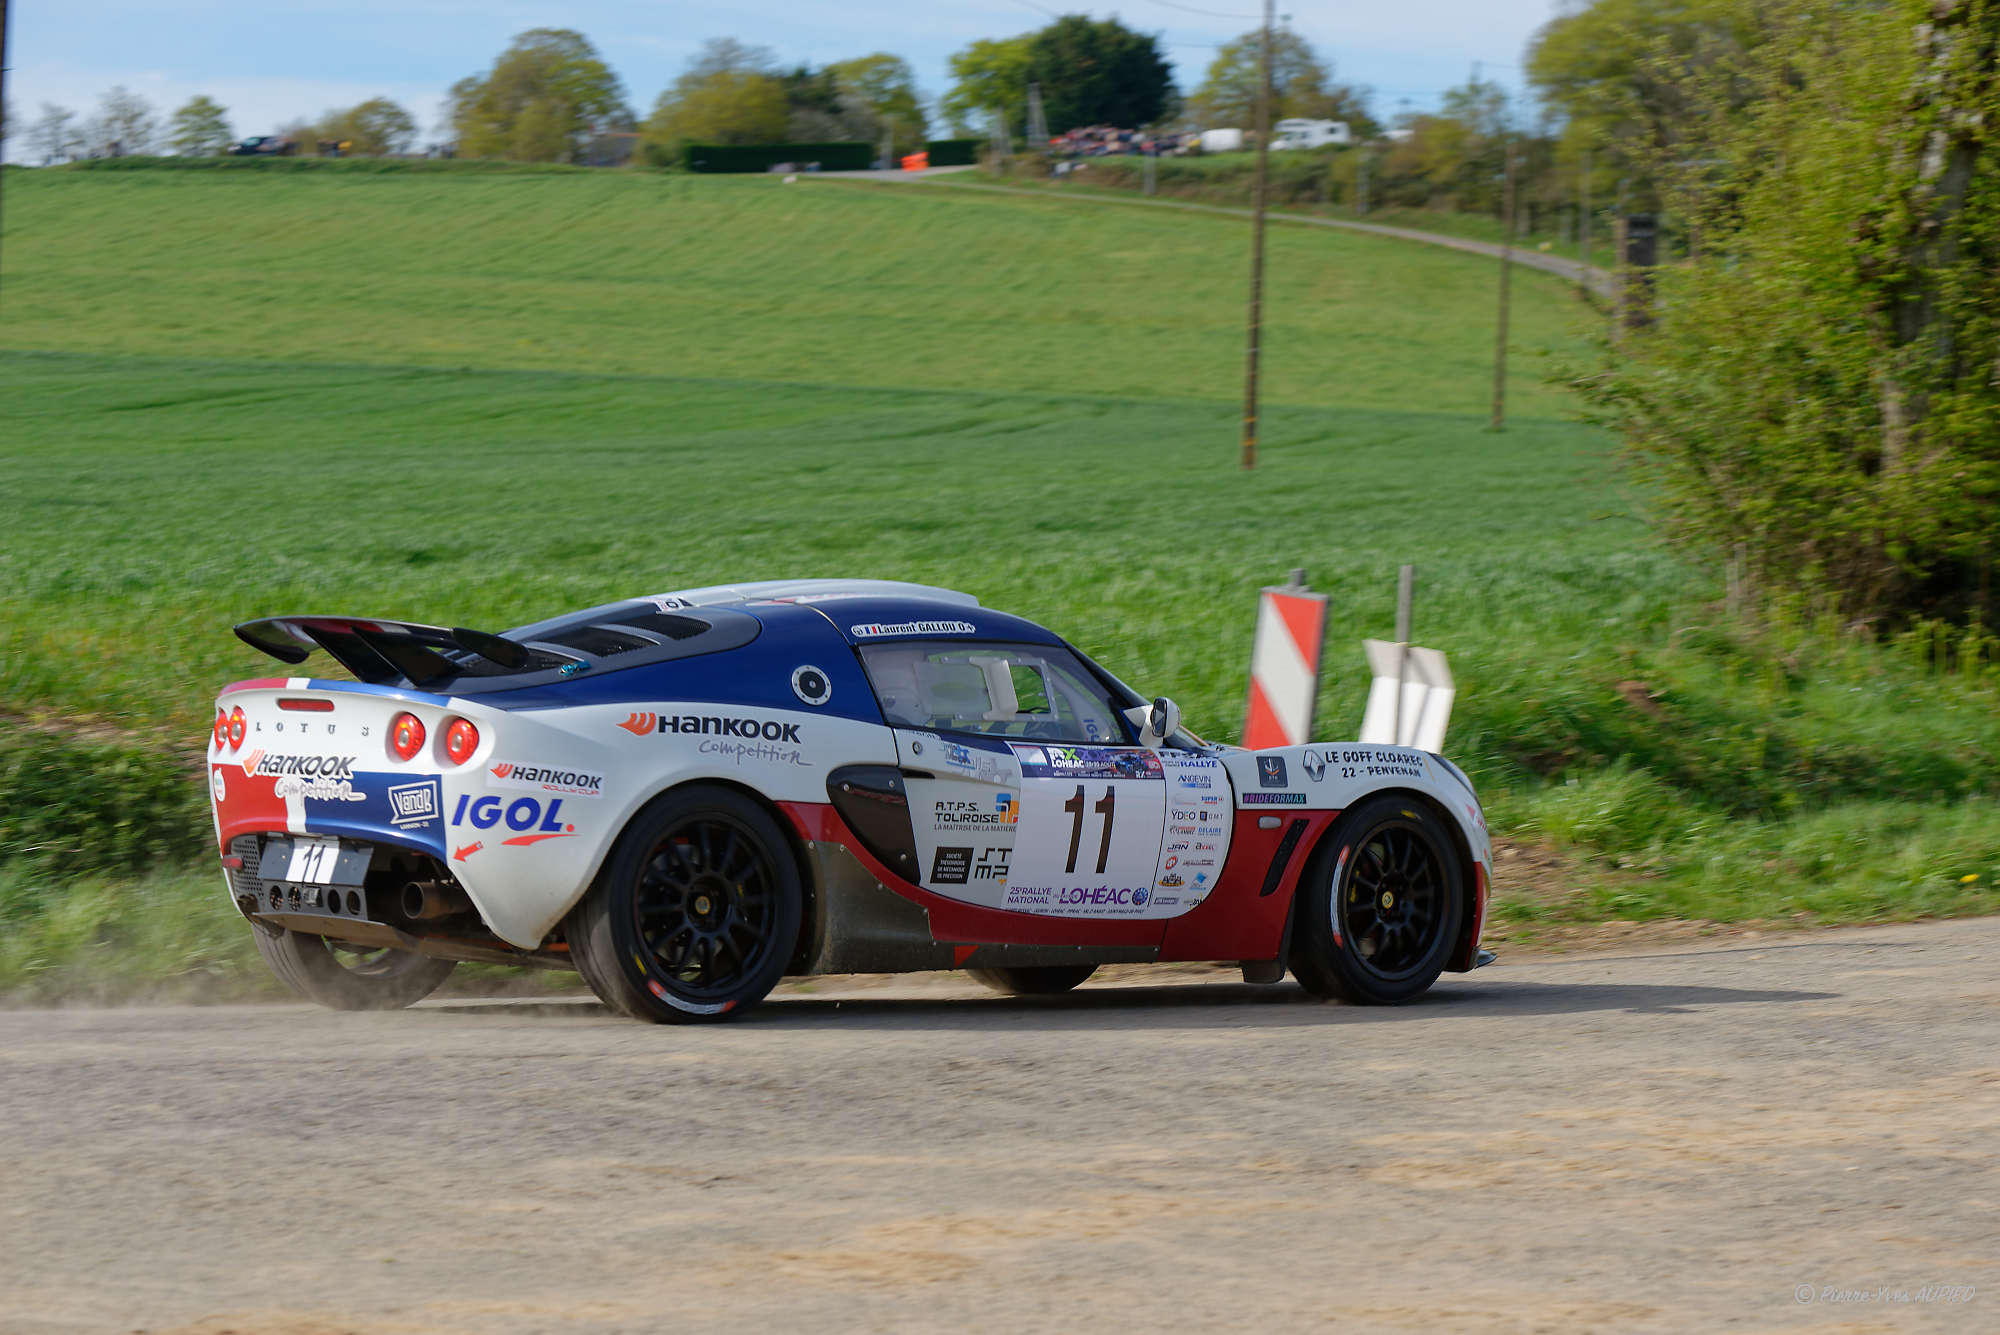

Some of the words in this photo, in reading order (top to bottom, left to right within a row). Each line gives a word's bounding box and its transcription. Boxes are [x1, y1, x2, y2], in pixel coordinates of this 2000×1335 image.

[878, 624, 917, 634] Laurent
[918, 622, 956, 632] GALLOU
[256, 722, 370, 737] LOTUS
[699, 740, 814, 765] Competition
[1325, 751, 1340, 764] LE
[1343, 751, 1373, 763] GOFF
[1376, 751, 1423, 767] CLOAREC
[1180, 760, 1217, 768] RALLYE
[1341, 767, 1357, 778] 22
[1367, 766, 1422, 778] PENVENAN
[1065, 784, 1115, 874] 11
[303, 843, 327, 884] 11
[1007, 895, 1050, 904] NATIONAL
[1059, 885, 1132, 905] LOHÉAC
